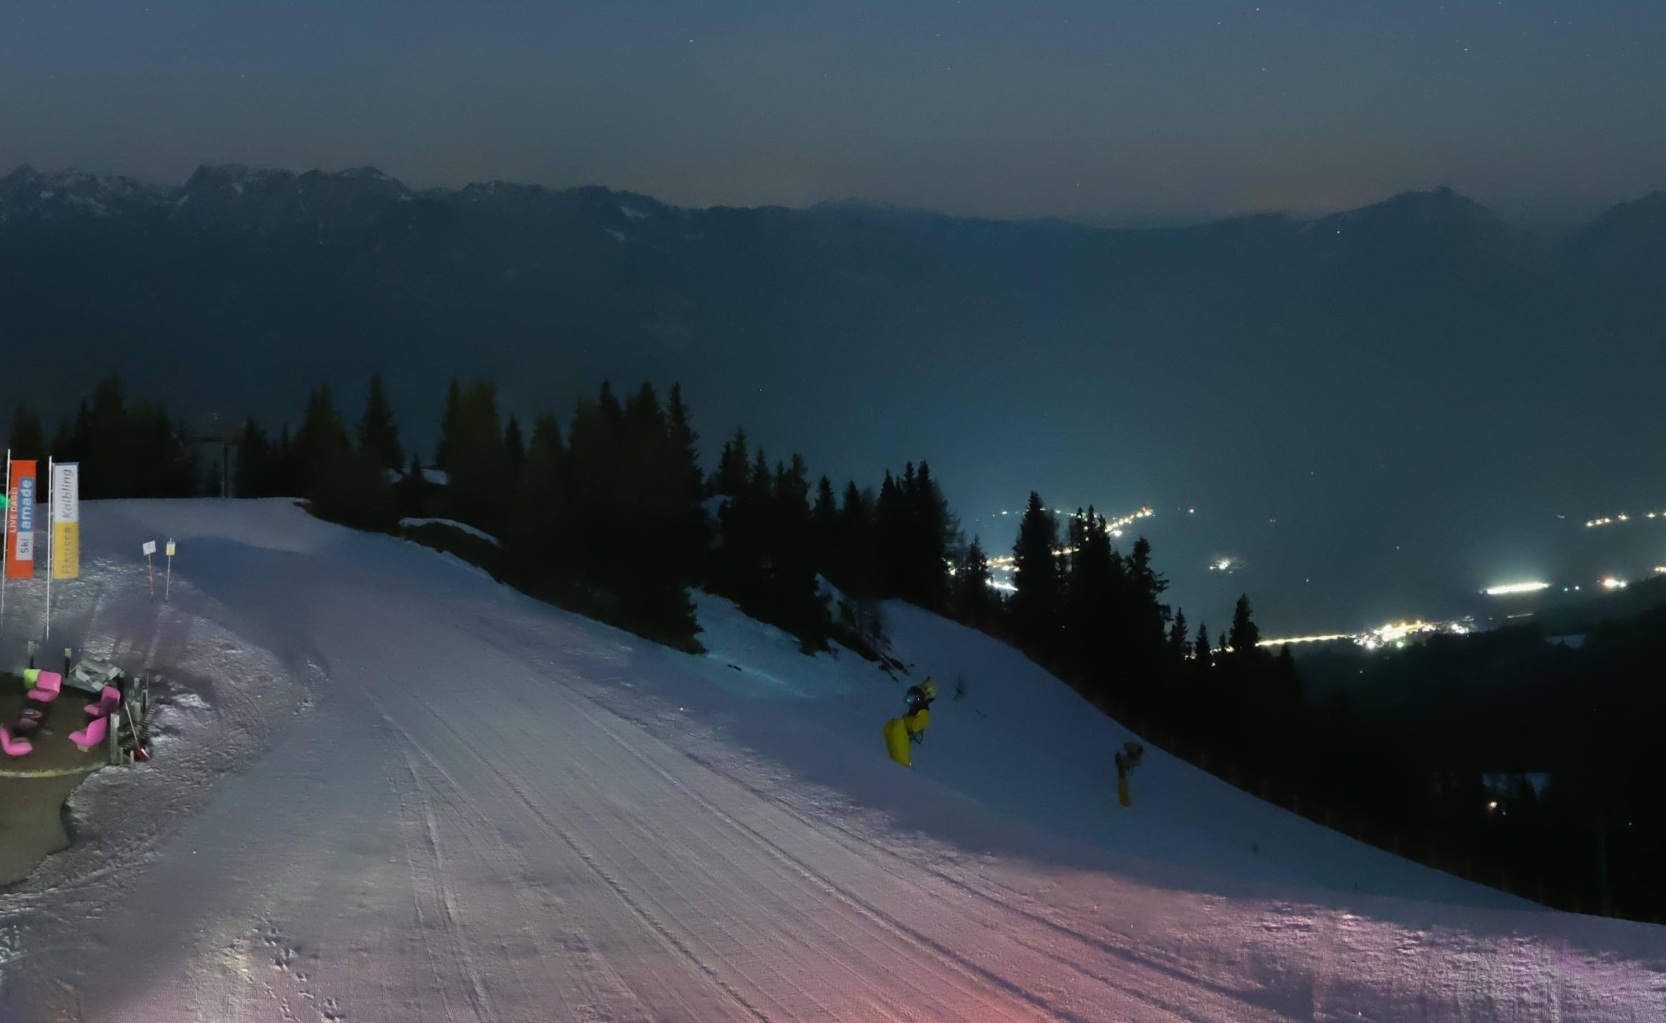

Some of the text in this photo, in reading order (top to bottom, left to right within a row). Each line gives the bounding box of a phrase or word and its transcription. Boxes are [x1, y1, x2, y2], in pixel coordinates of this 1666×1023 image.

[20, 538, 29, 554] Ski
[62, 468, 74, 574] HAUSER Kaibling
